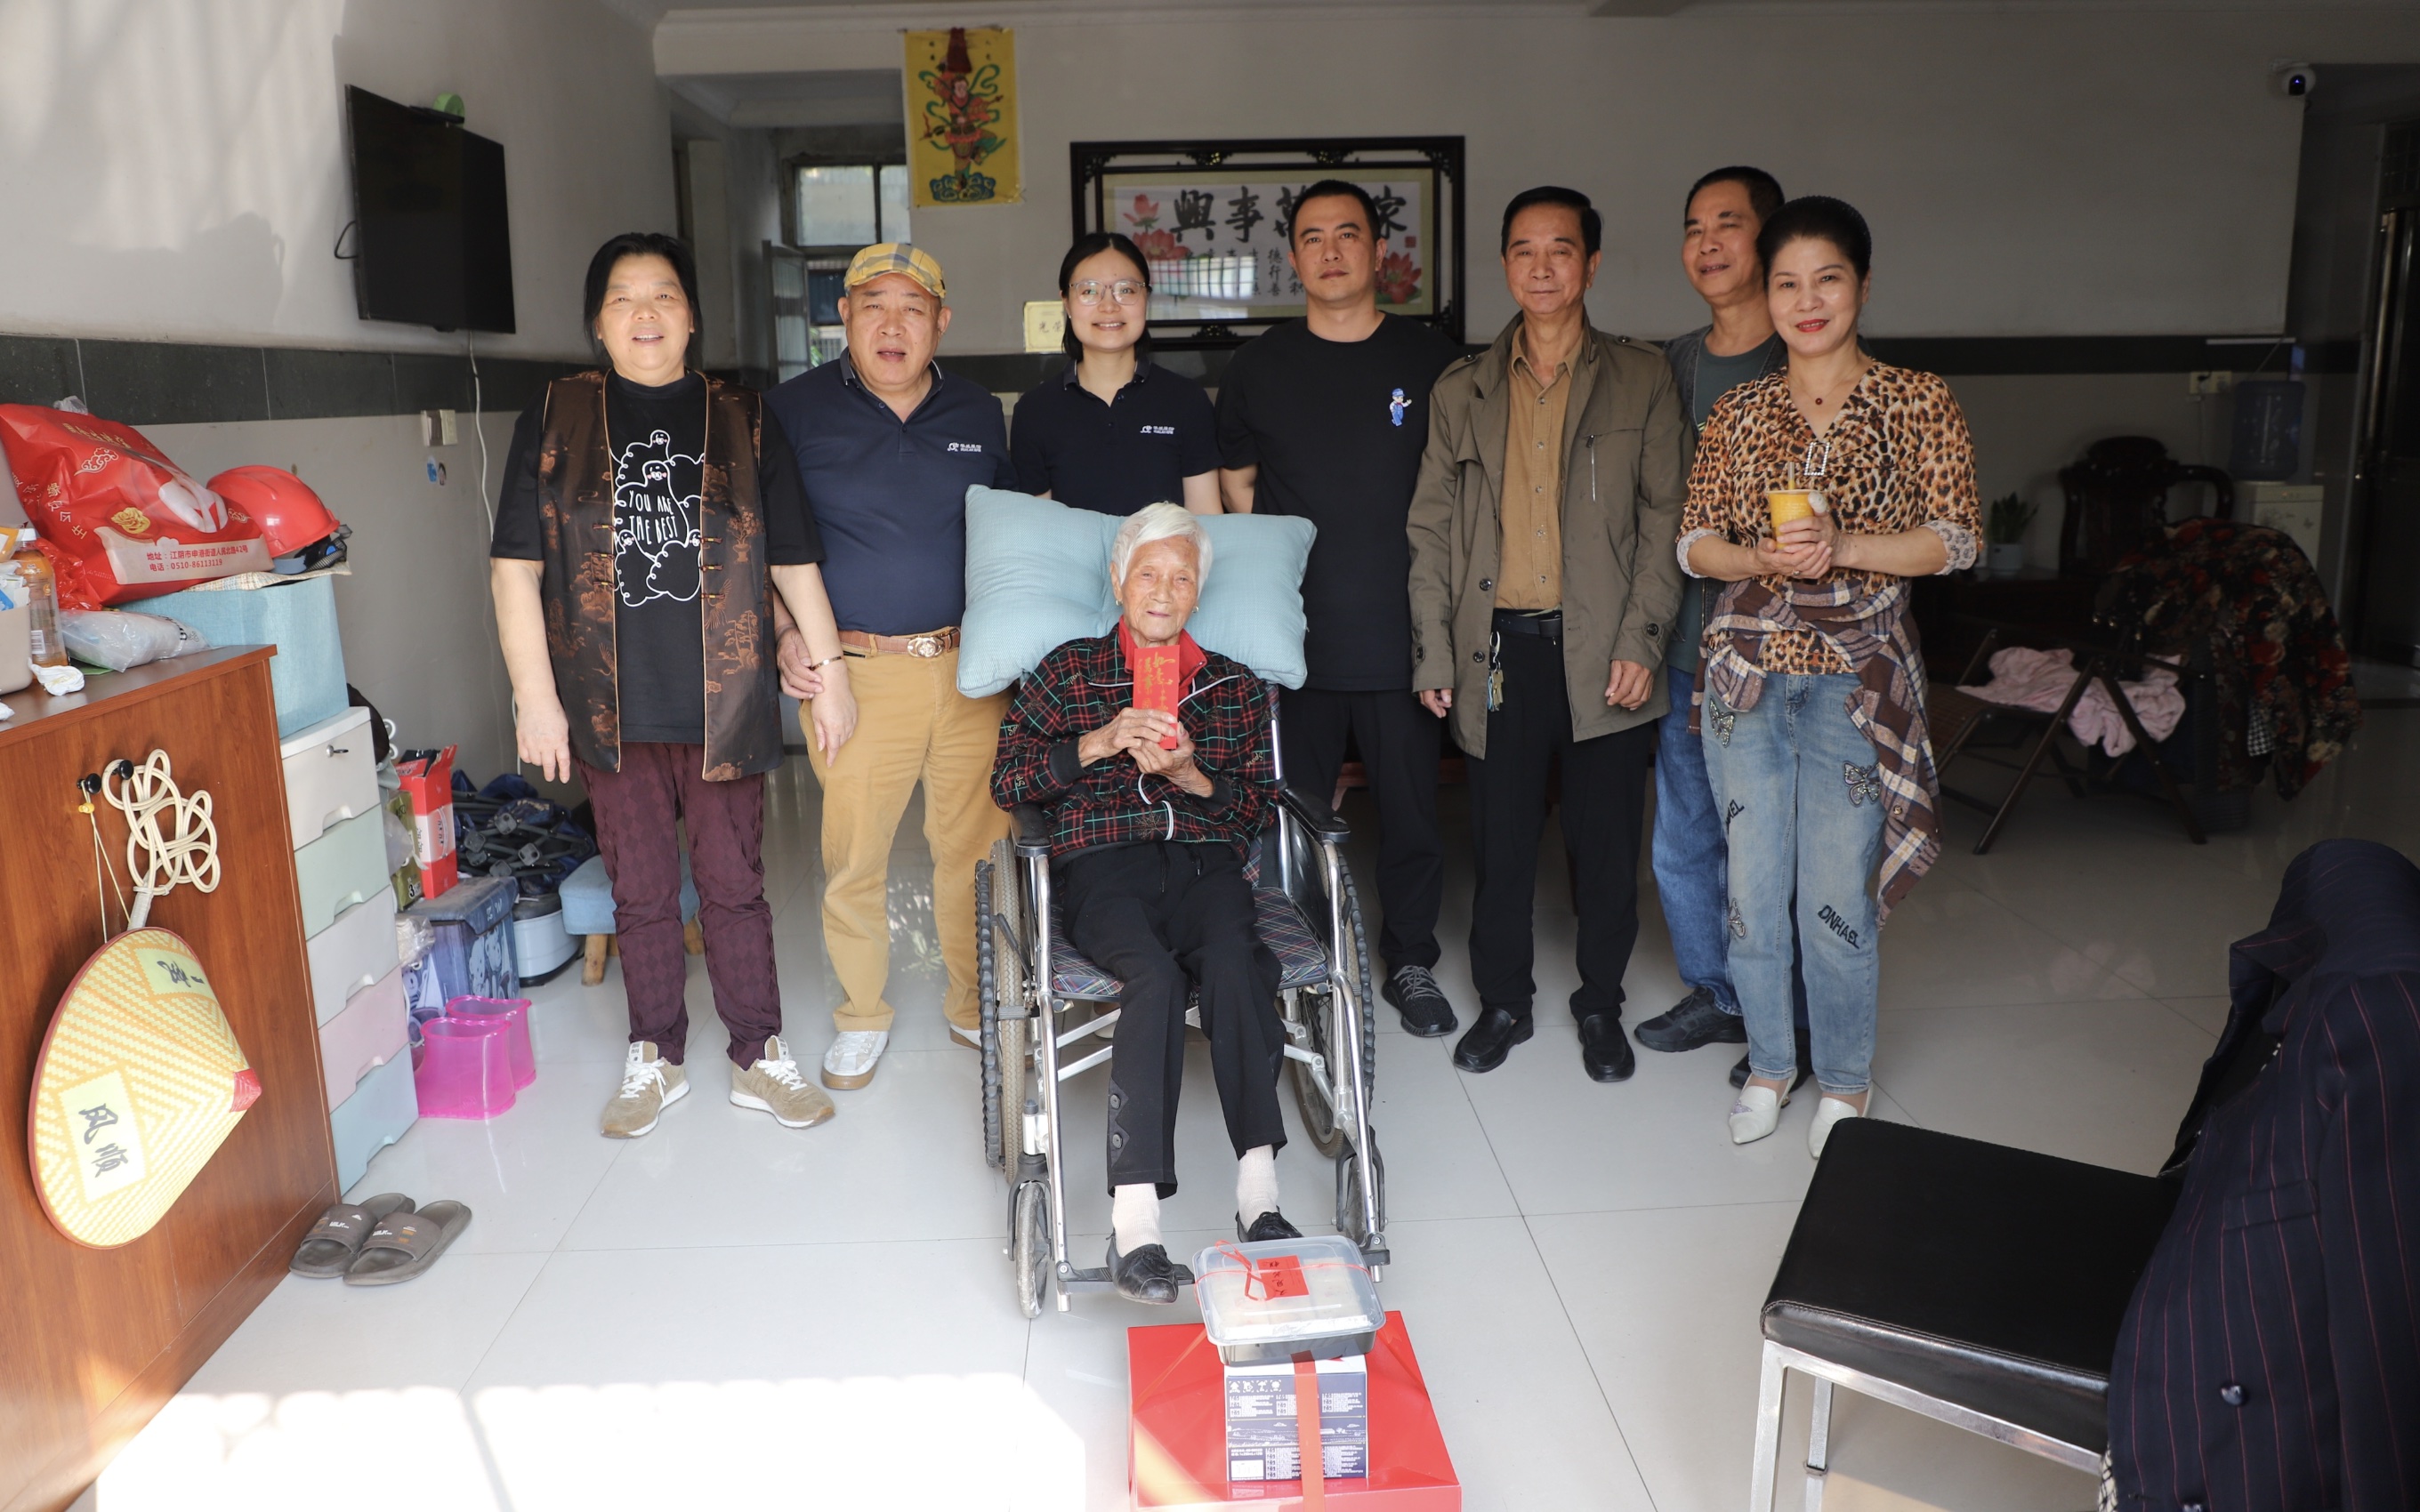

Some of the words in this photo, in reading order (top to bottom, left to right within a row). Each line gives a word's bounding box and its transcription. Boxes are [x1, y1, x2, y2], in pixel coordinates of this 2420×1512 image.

[629, 490, 651, 512] YOU
[657, 495, 674, 516] ARE
[629, 516, 652, 545] THE
[655, 516, 678, 544] BEST
[1818, 904, 1860, 949] DNHAEL
